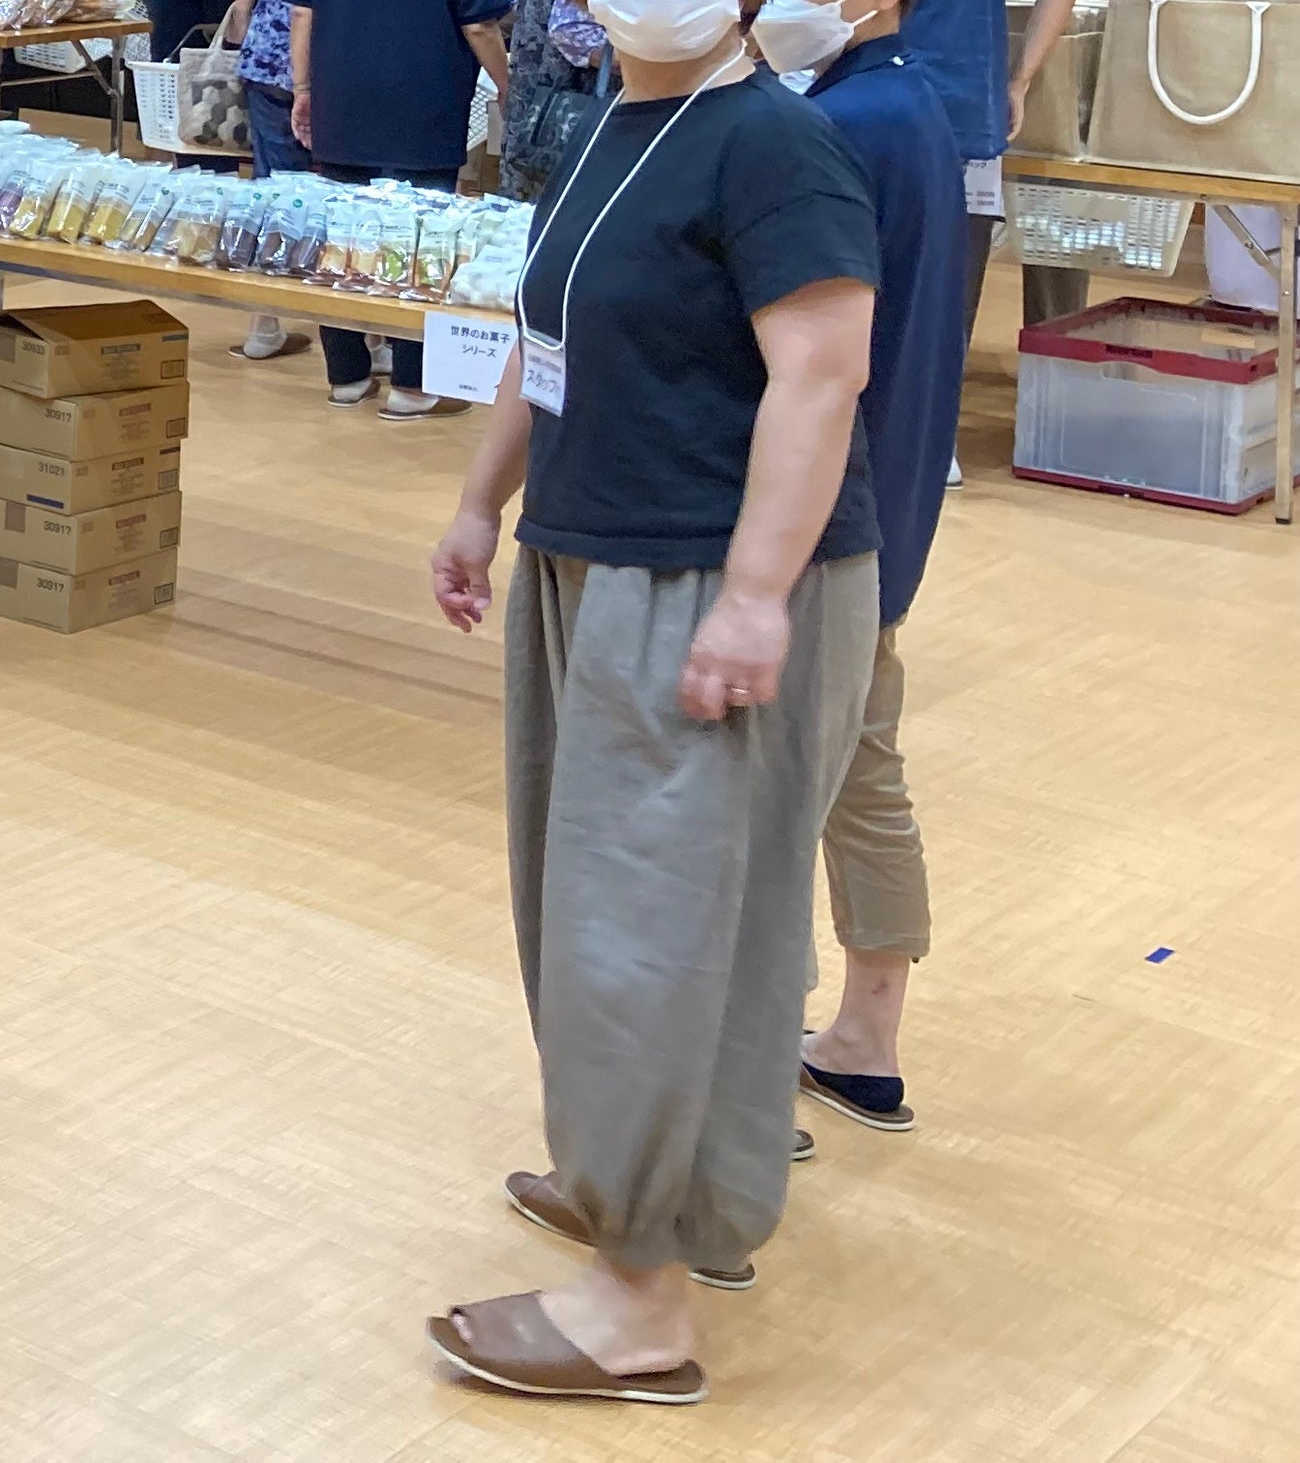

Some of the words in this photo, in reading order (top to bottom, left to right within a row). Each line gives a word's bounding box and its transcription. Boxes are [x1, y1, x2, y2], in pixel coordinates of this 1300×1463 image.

[450, 325, 511, 344] 世界のお菓子
[462, 344, 497, 358] シリーズ
[45, 407, 73, 423] 30917
[43, 520, 72, 536] 30917
[36, 577, 65, 593] 30917
